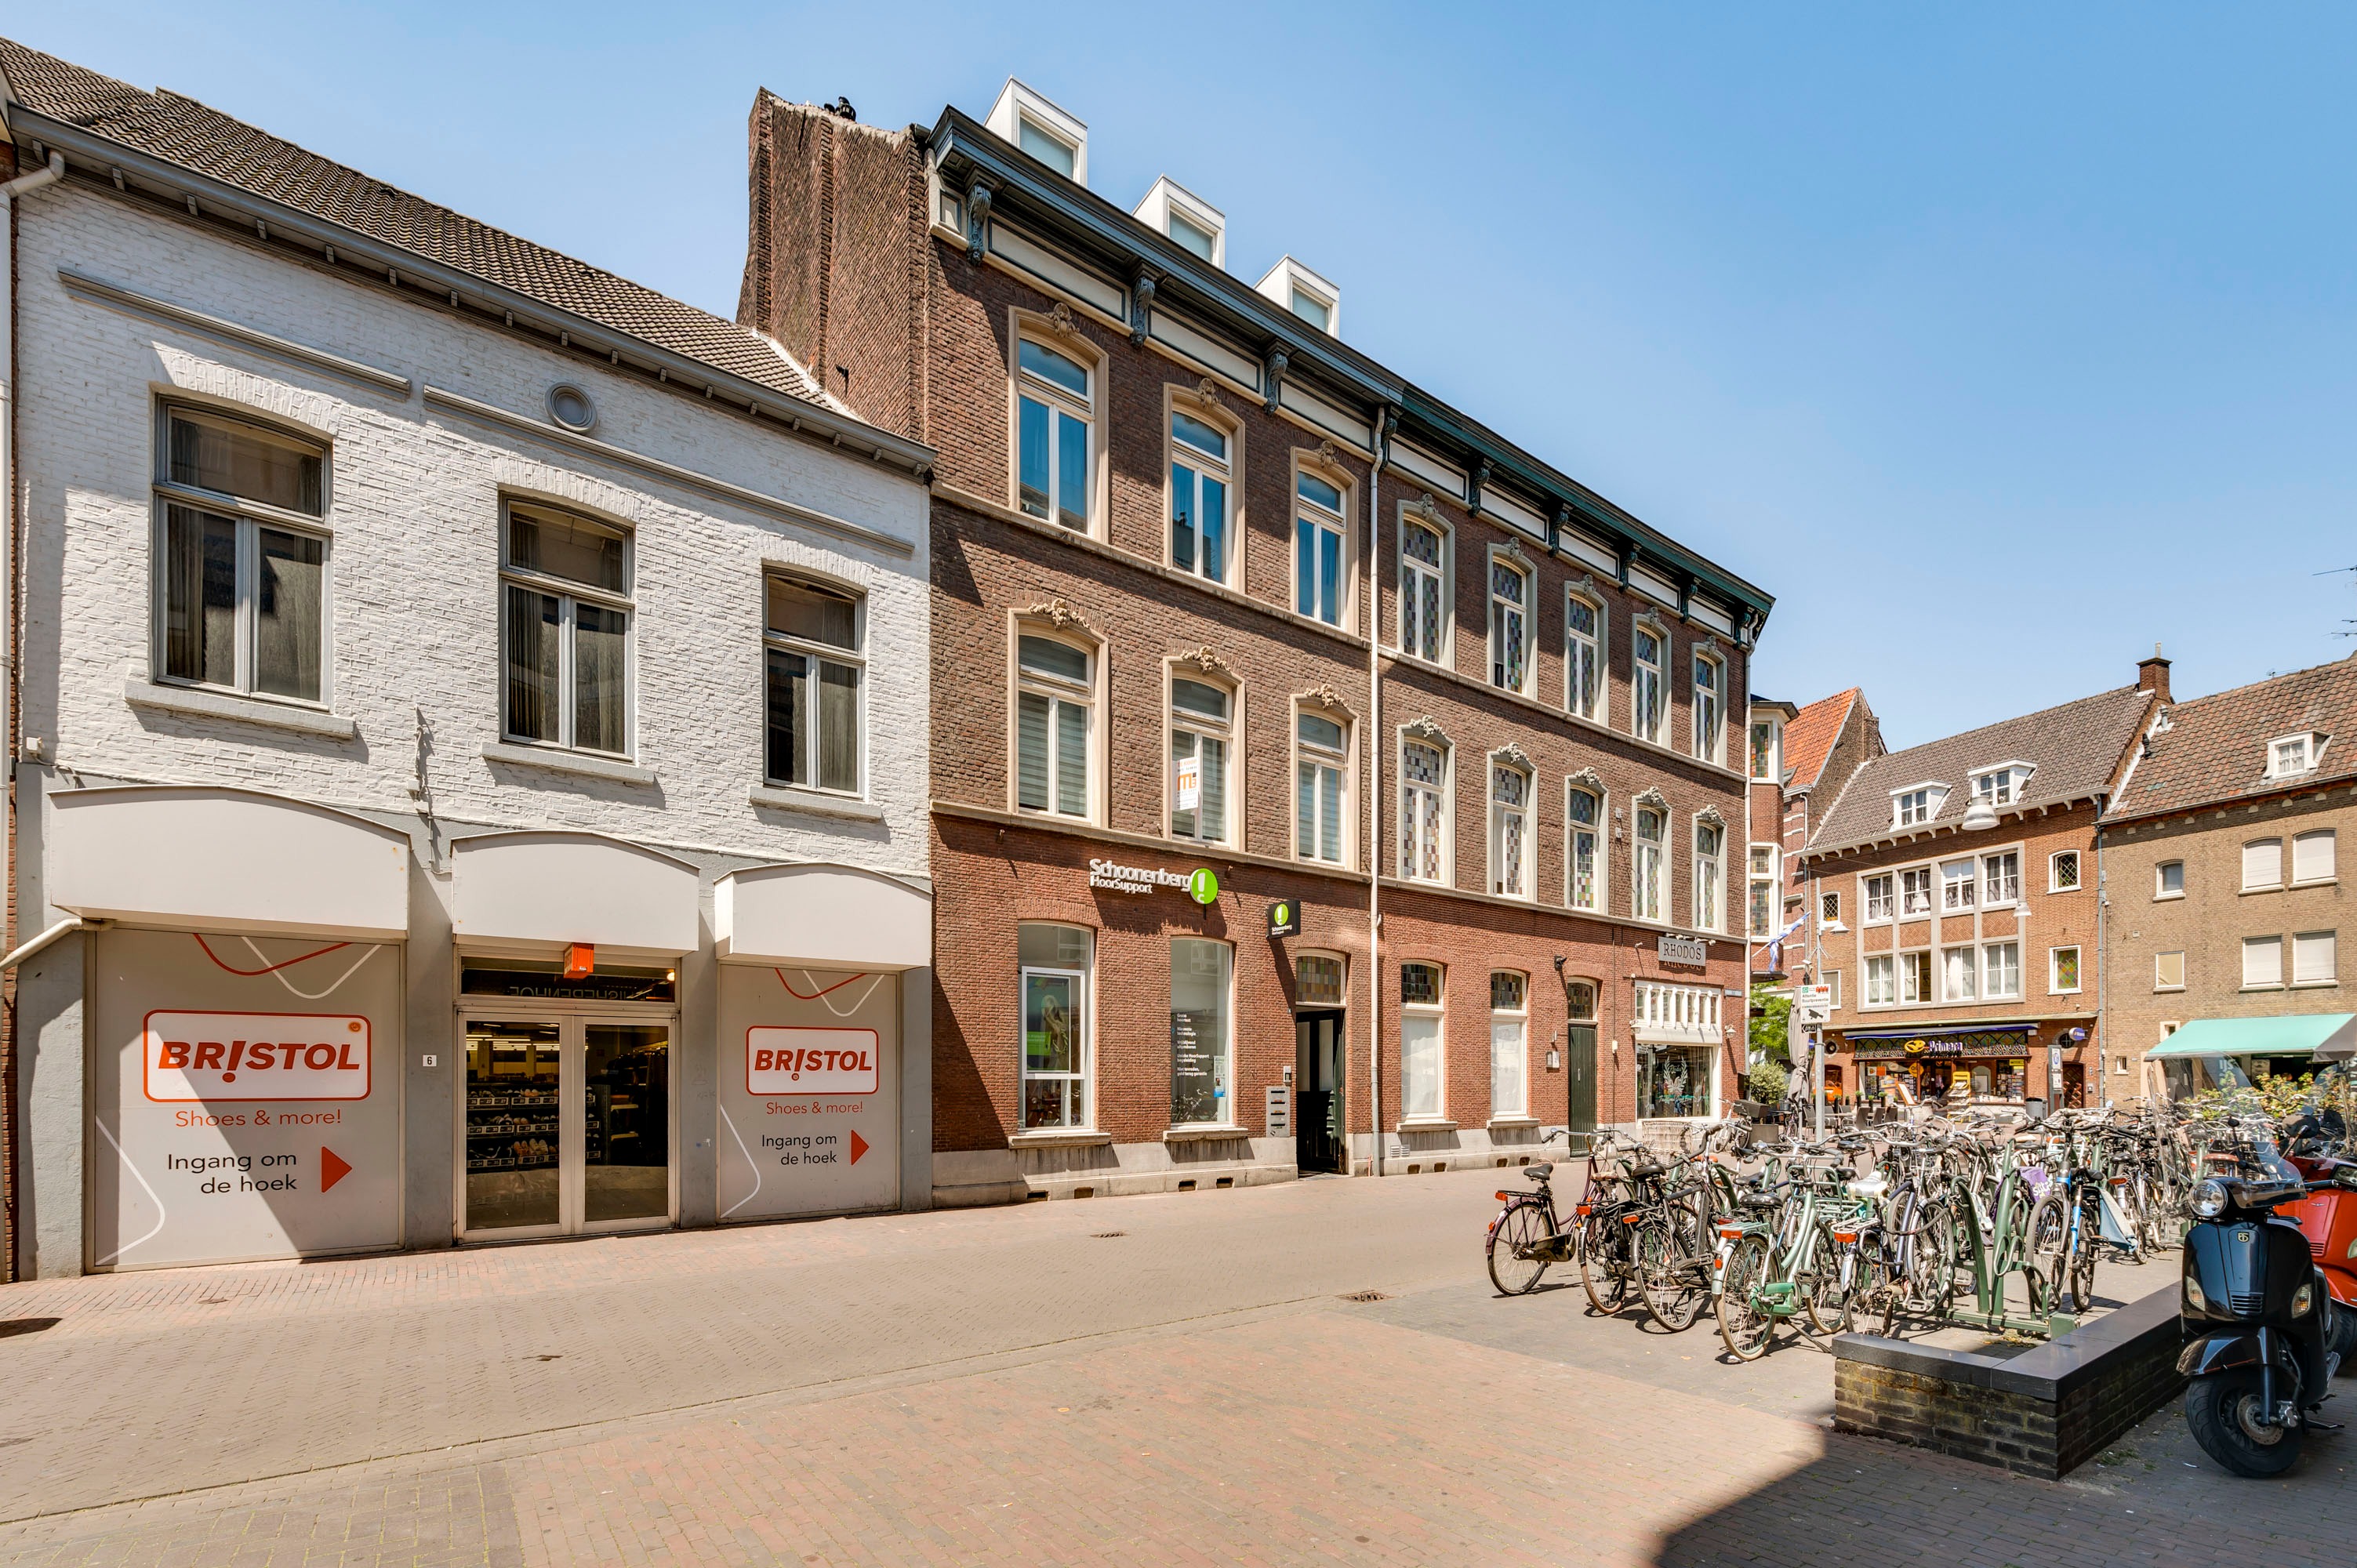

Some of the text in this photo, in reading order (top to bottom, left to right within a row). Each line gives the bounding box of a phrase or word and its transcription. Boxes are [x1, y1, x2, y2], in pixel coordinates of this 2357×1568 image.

[1089, 858, 1191, 892] Schoonenberg
[1090, 875, 1153, 894] HoorSupport
[1663, 943, 1701, 960] RHODOS
[1929, 1040, 1963, 1051] Primera
[427, 1056, 433, 1065] 6
[766, 1101, 863, 1115] Shoes & more!
[175, 1109, 342, 1127] Shoes & more!
[761, 1134, 837, 1150] Ingang om
[168, 1154, 296, 1174] Ingang om
[780, 1150, 837, 1166] de hoek
[200, 1174, 297, 1194] de hoek
